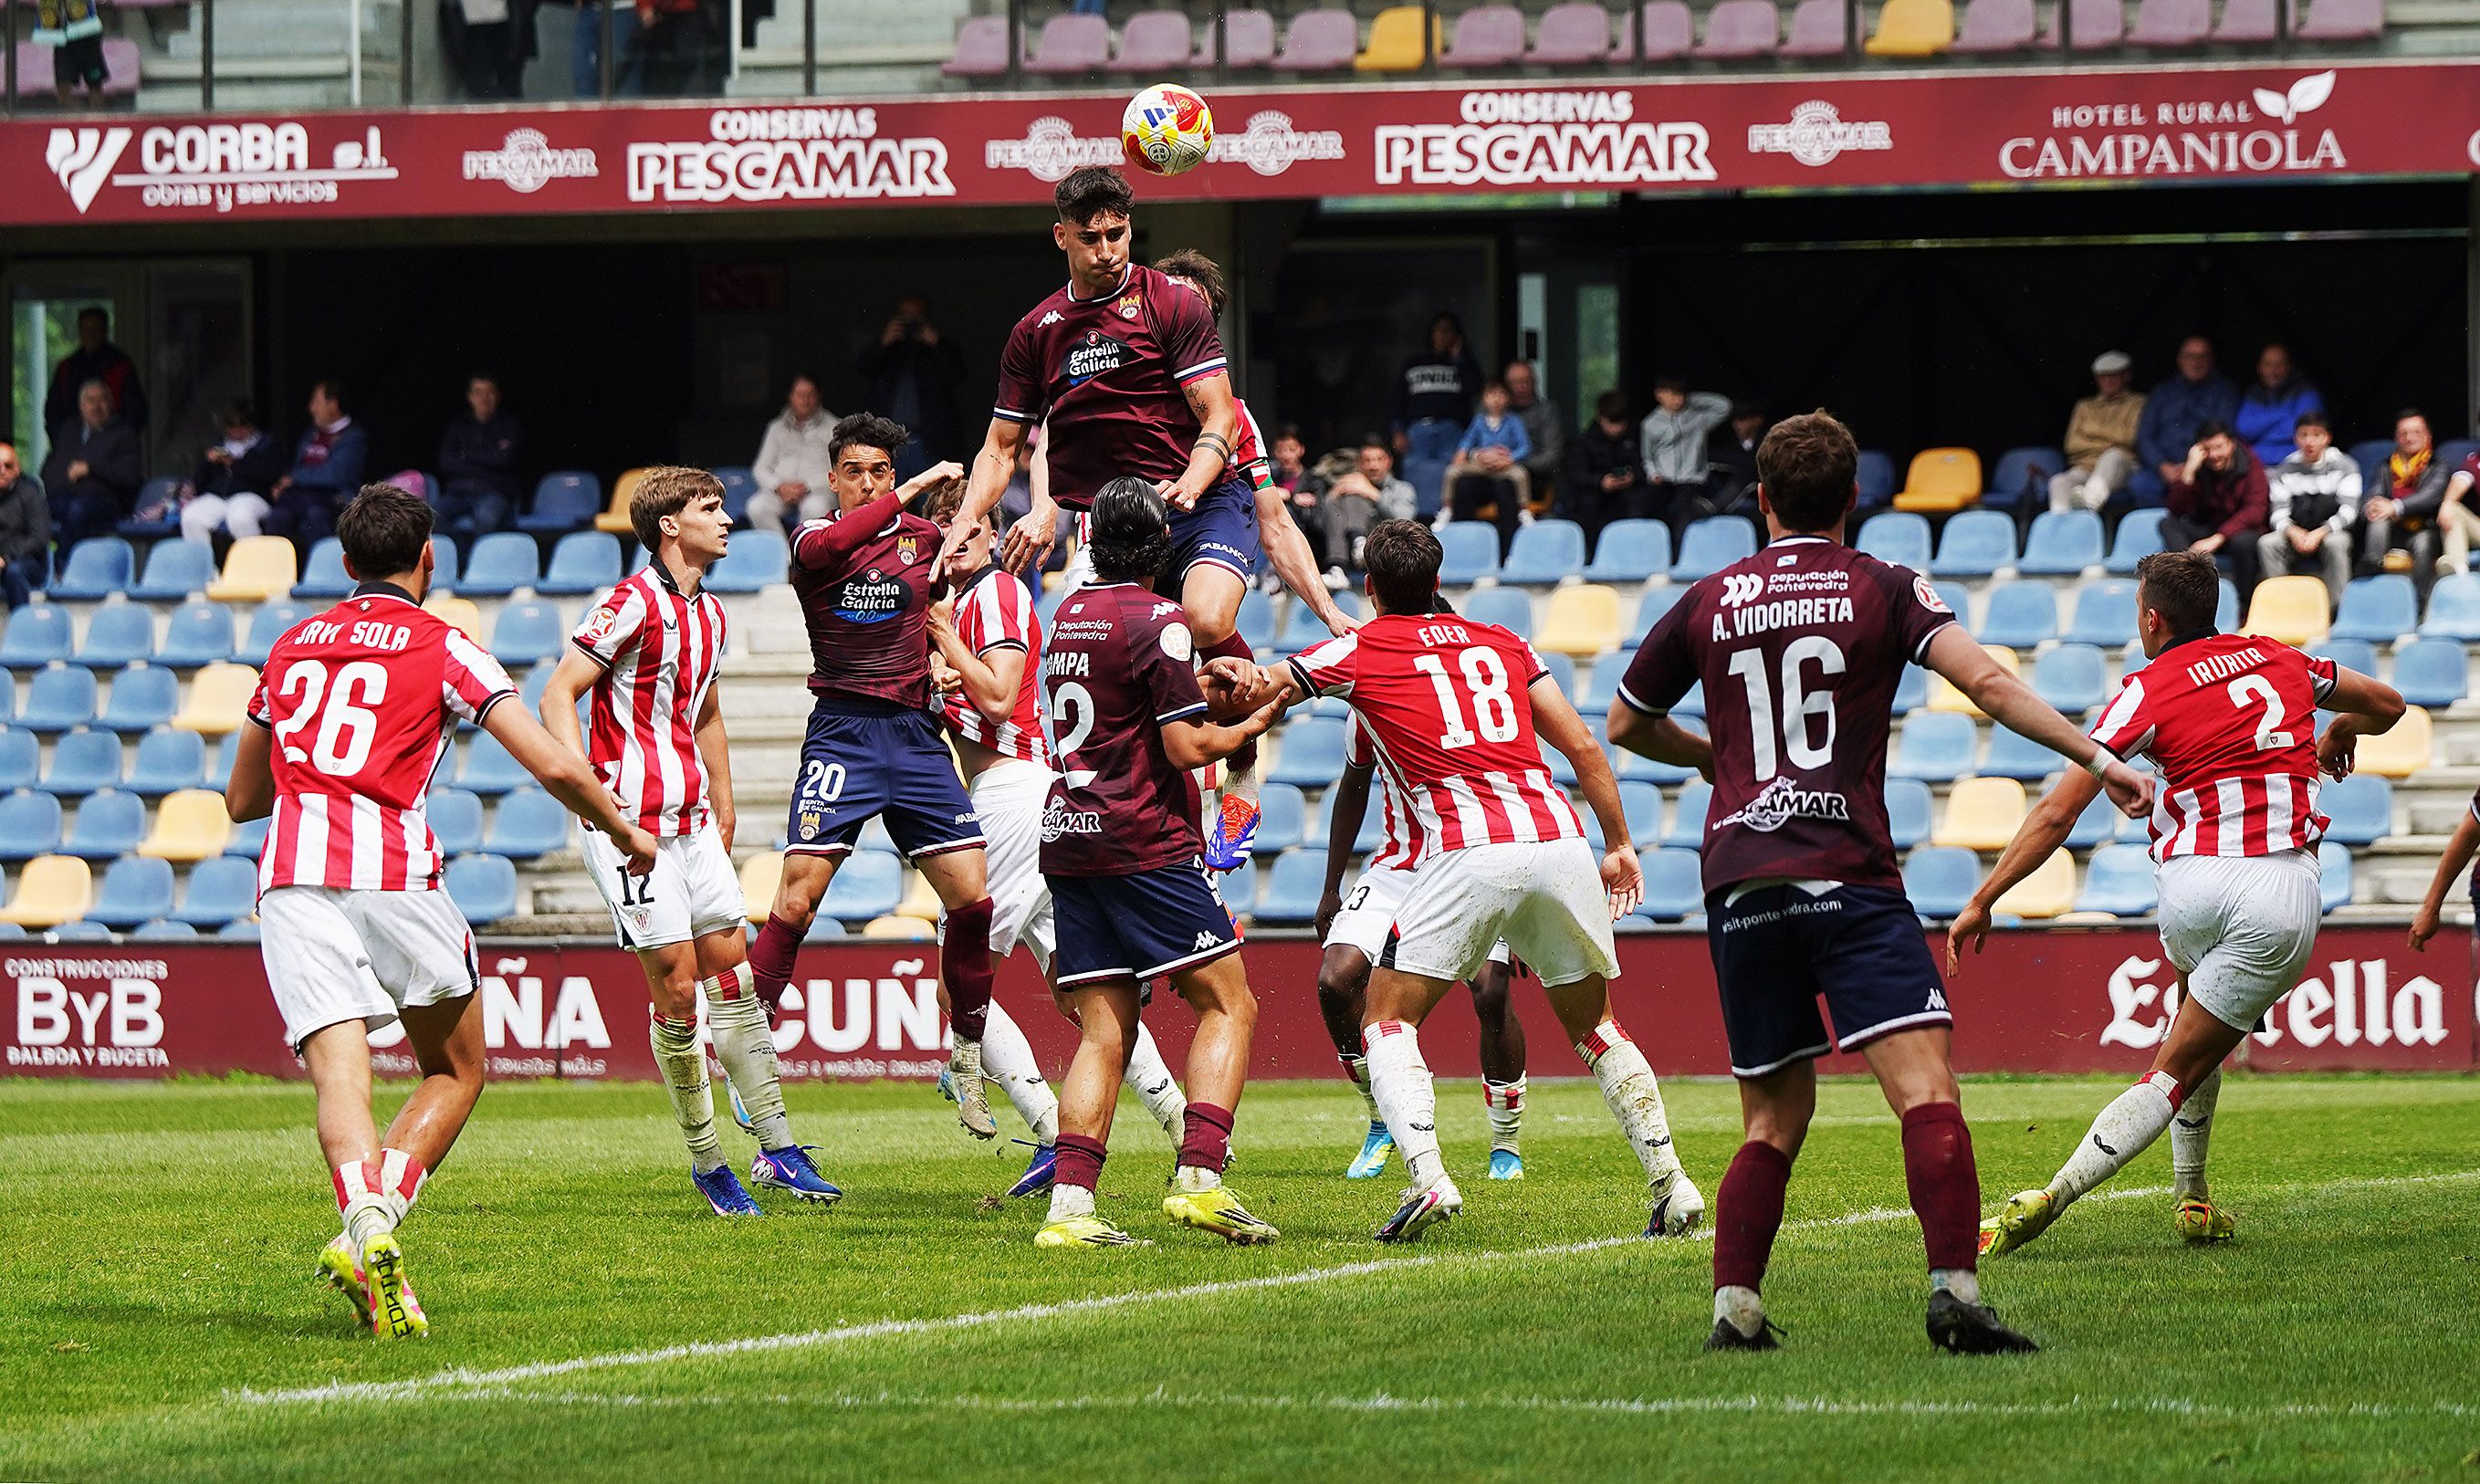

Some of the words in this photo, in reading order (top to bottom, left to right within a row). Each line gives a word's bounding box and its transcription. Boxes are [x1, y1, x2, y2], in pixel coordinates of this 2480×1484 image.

[1460, 90, 1634, 123] CONSERVAS
[2052, 103, 2148, 129] HOTEL
[2157, 100, 2255, 125] RURAL
[710, 108, 878, 141] CONSERVAS
[1748, 121, 1894, 153] PESCAMAR
[141, 122, 309, 173] CORBA
[986, 137, 1126, 169] PESCAMAR
[1375, 120, 1719, 184] PESCAMAR
[1998, 128, 2348, 178] CAMPANIOLA
[463, 148, 600, 180] PESCAMAR
[627, 137, 957, 203] PESCAMAR
[142, 183, 212, 207] obras
[215, 183, 233, 213] y
[236, 181, 338, 205] servicios
[1069, 342, 1120, 364] Estrella
[1069, 356, 1120, 376] Galicia
[841, 595, 896, 610] Galicia
[842, 582, 900, 597] Estrella
[1767, 580, 1849, 594] Pontevedra
[350, 621, 412, 651] SOLA
[1054, 631, 1108, 641] Pontevedra
[1059, 620, 1114, 632] Deputación
[1417, 625, 1470, 648] EDER
[1712, 613, 1732, 643] A.
[1733, 598, 1854, 637] VIDORRETA
[1047, 652, 1090, 677] OMPA
[2186, 647, 2268, 687] IRURITA
[1413, 645, 1520, 750] 18
[1728, 635, 1847, 782] 16
[2226, 674, 2295, 751] 2
[275, 659, 389, 777] 26
[1053, 682, 1098, 790] 2
[802, 760, 847, 801] 20
[5, 958, 169, 979] CONSTRUCCIONES
[6, 1046, 81, 1067] BALBOA
[81, 1046, 96, 1067] Y
[98, 1047, 170, 1067] BUCETA
